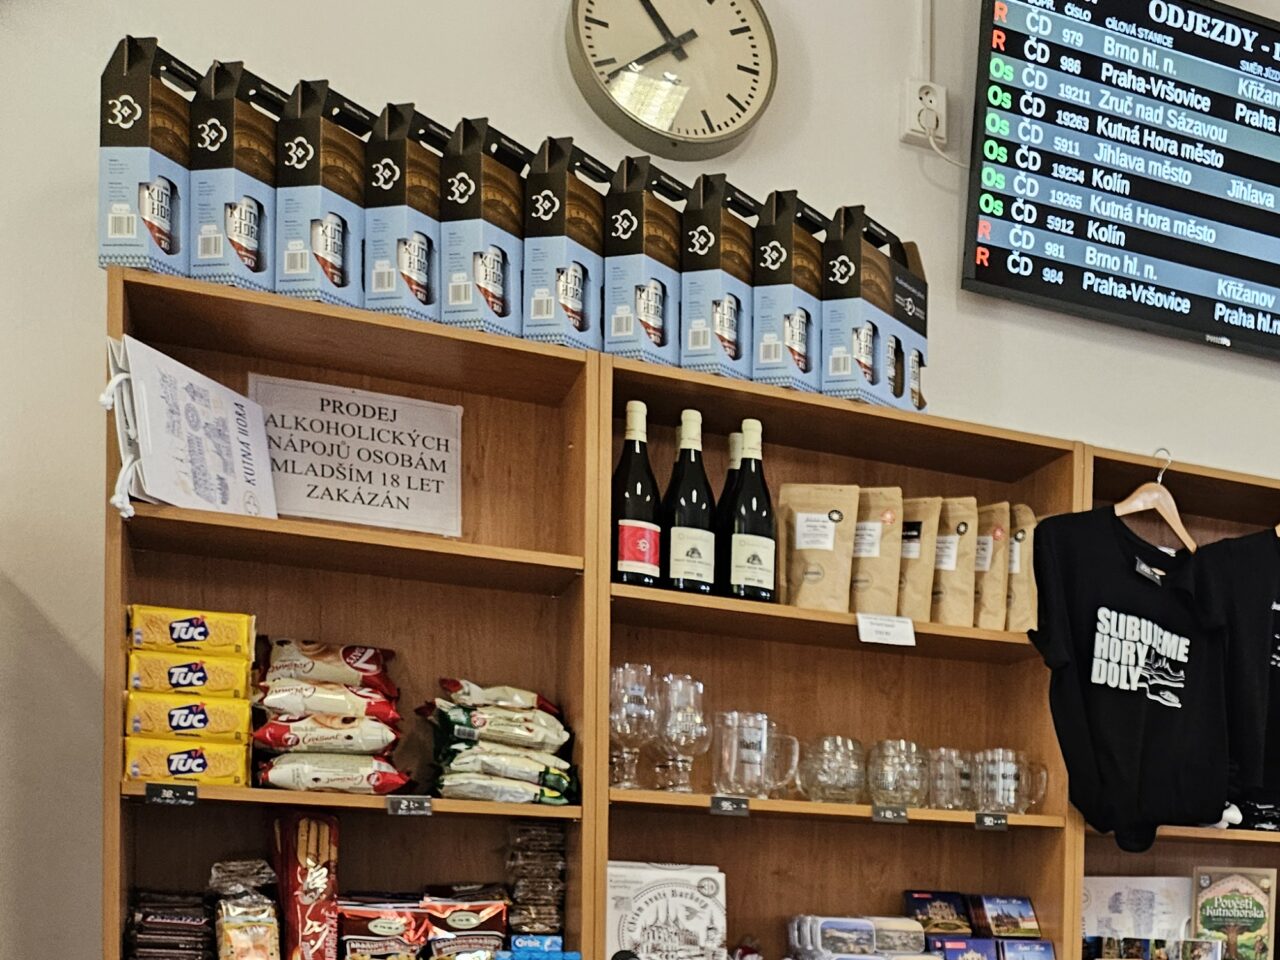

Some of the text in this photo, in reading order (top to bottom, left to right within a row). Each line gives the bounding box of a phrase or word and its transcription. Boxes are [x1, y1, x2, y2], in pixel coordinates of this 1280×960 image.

[994, 2, 1007, 23] R
[1026, 9, 1051, 36] ČD
[1062, 29, 1083, 46] 979
[1103, 36, 1139, 63] Brno
[1149, 1, 1258, 53] ODJEZDY
[990, 57, 1014, 81] Os
[1022, 64, 1048, 90] ČD
[1058, 83, 1091, 105] 19211
[1098, 90, 1132, 115] Zruč
[1135, 102, 1163, 125] nad
[1166, 108, 1228, 143] Sázavou
[992, 30, 1005, 50] R
[1024, 36, 1050, 63] ČD
[1060, 56, 1081, 74] 986
[1101, 63, 1211, 112] Praha-Vršovice
[1235, 104, 1276, 133] Praha
[987, 85, 1012, 109] Os
[1020, 91, 1046, 118] ČD
[1097, 116, 1140, 143] Kutná
[1143, 129, 1178, 155] Hora
[1181, 143, 1224, 168] město
[983, 140, 1007, 163] Os
[1015, 145, 1041, 171] ČD
[1051, 163, 1084, 184] 19254
[1092, 168, 1130, 195] Kolín
[985, 112, 1009, 135] Os
[1018, 118, 1043, 145] ČD
[1053, 136, 1080, 156] 5911
[1094, 142, 1145, 172] Jihlava
[1149, 155, 1192, 185] město
[1227, 179, 1275, 209] Jihlava
[979, 194, 1003, 216] Os
[1011, 198, 1037, 224] ČD
[1046, 216, 1074, 235] 5912
[1087, 221, 1125, 246] Kolín
[981, 167, 1005, 189] Os
[1013, 172, 1039, 197] ČD
[1050, 189, 1082, 210] 19265
[1090, 195, 1133, 223] Kutná
[1136, 208, 1170, 233] Hora
[1173, 219, 1216, 244] město
[975, 247, 989, 266] R
[1007, 250, 1033, 275] ČD
[1042, 268, 1063, 284] 984
[1083, 272, 1191, 314] Praha-Vršovice
[1214, 303, 1255, 329] Praha
[977, 221, 991, 240] R
[1009, 224, 1035, 250] ČD
[1045, 242, 1065, 259] 981
[1085, 246, 1120, 271] Brno
[1217, 278, 1275, 308] Křižanov
[265, 414, 449, 452] ALKOHOLICKÝCH
[320, 398, 398, 423] PRODEJ
[268, 435, 446, 473] NÁPOJŮ OSOBÁM
[271, 458, 445, 493] MLADŠÍM 18 LET
[306, 484, 410, 510] ZAKÁZÁN
[1091, 658, 1142, 691] DOLY
[1094, 632, 1149, 667] HORY
